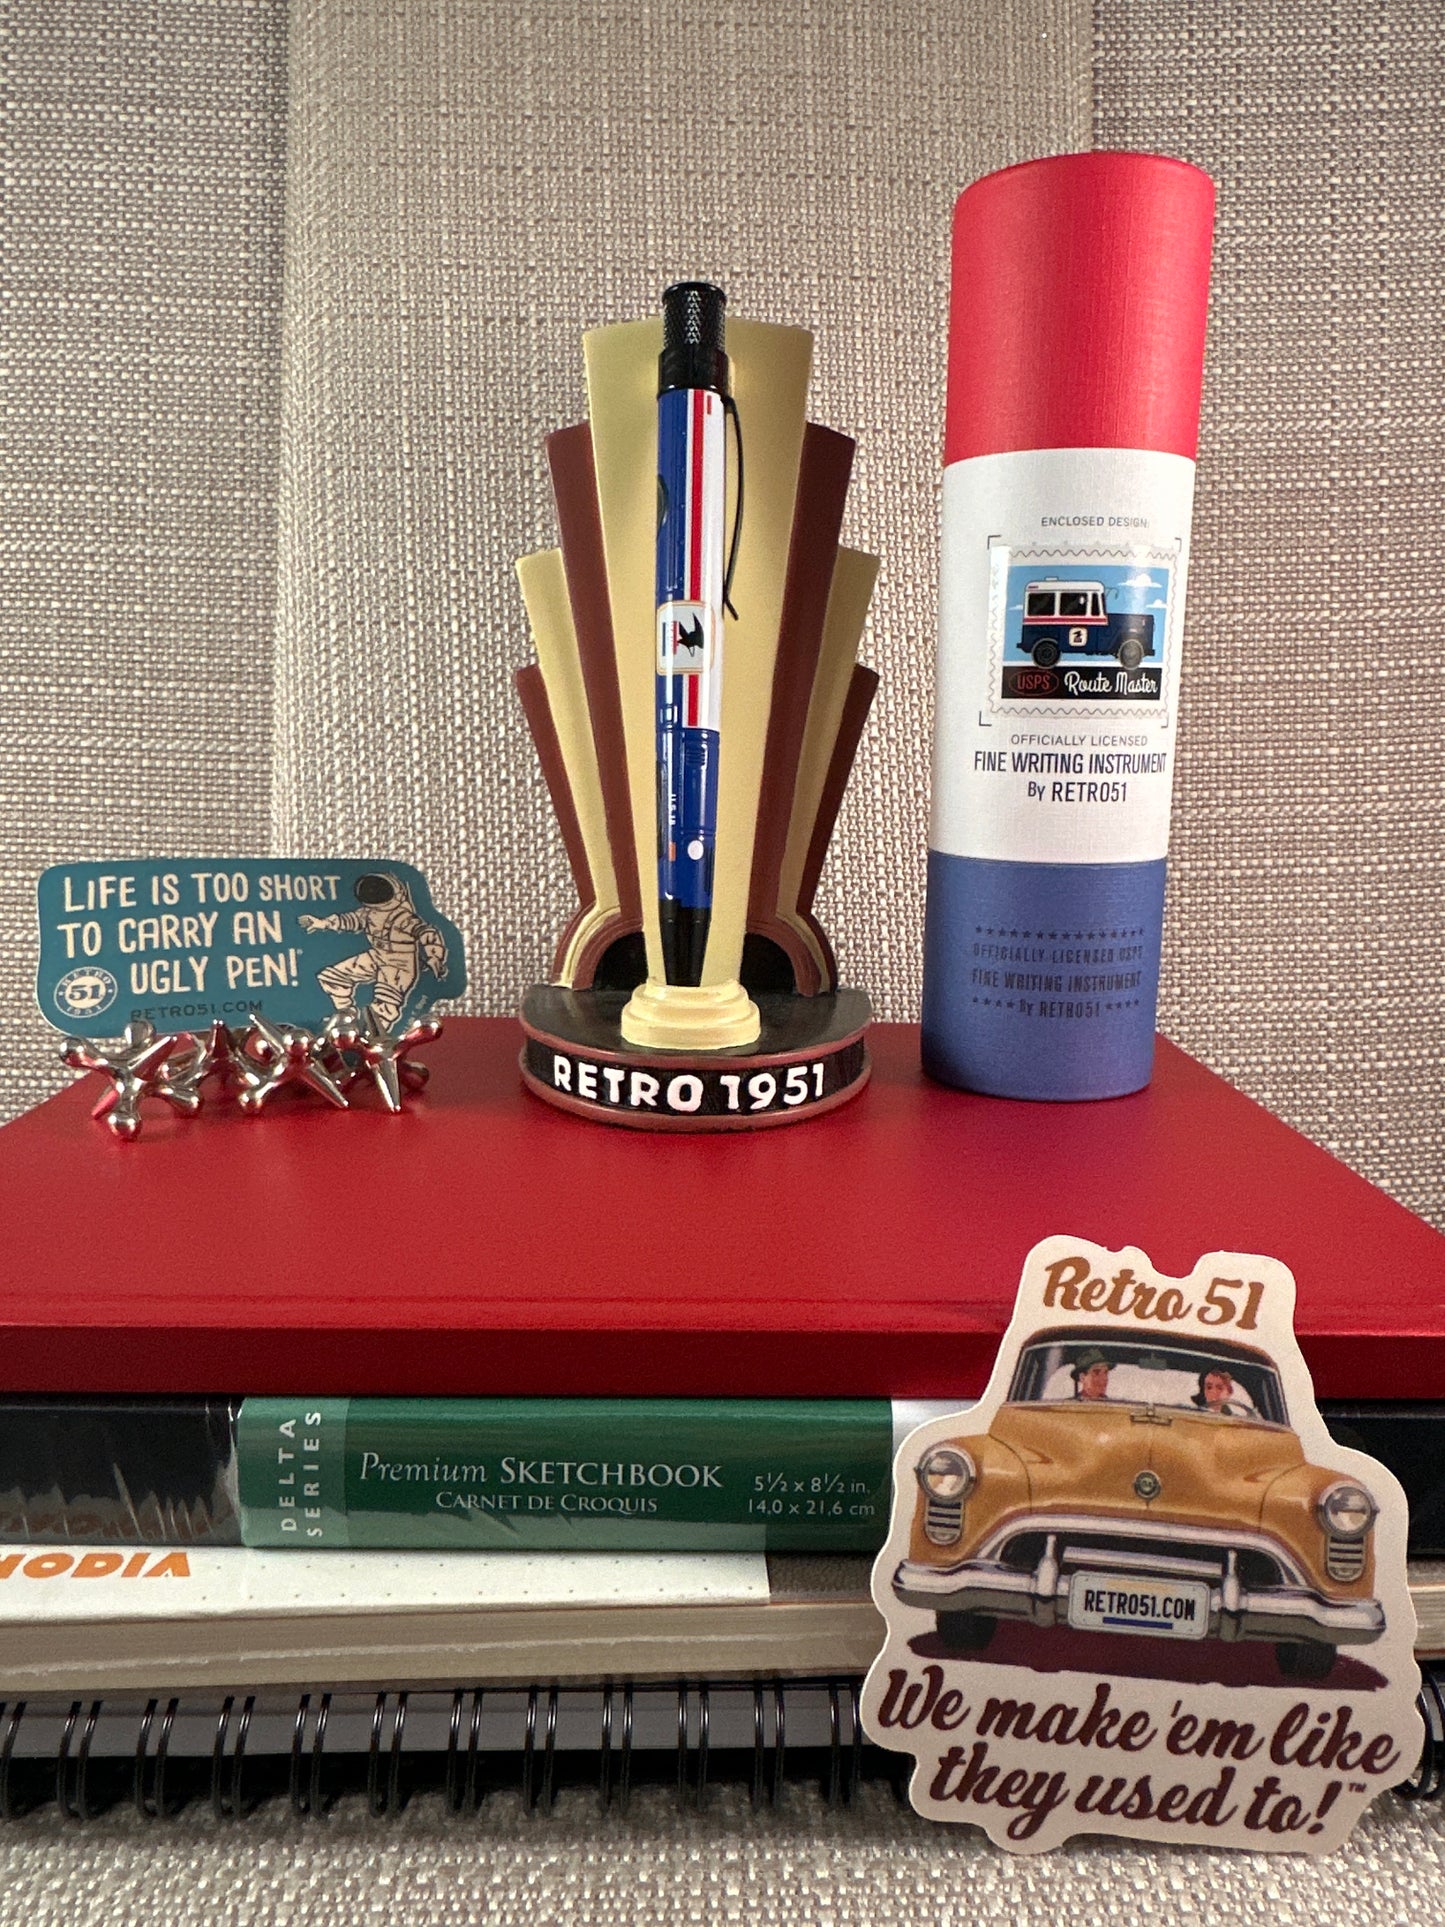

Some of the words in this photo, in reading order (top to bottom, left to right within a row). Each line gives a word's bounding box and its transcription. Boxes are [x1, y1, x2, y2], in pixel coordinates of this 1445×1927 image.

[1040, 515, 1105, 527] ENCLOSED
[1108, 516, 1149, 528] DESIGN
[1016, 673, 1050, 690] USPS
[1063, 670, 1113, 696] Route
[1113, 669, 1159, 694] Master
[1010, 734, 1086, 747] OFFICIALLY
[1091, 735, 1148, 747] LICENSED
[973, 750, 1008, 773] FINE
[1010, 751, 1084, 774] WRITING
[1088, 752, 1167, 775] INSTRUMENT
[1027, 780, 1046, 801] By
[1051, 781, 1128, 803] RETRO51
[63, 875, 138, 913] LIFE
[151, 872, 180, 907] IS
[191, 871, 249, 903] TOO
[258, 874, 342, 902] SHORT
[56, 920, 102, 959] TO
[117, 910, 220, 955] CARRY
[232, 910, 284, 946] AN
[972, 942, 1045, 963] OFFICIALLY
[1051, 947, 1114, 964] LICENSED
[129, 955, 210, 996] UGLY
[971, 967, 999, 989] FINE
[1003, 971, 1063, 993] WRITING
[1067, 970, 1142, 993] INSTRUMENT
[68, 984, 101, 1001] 51
[130, 999, 263, 1021] RETRO51.COM
[1038, 1000, 1101, 1019] RETRO51
[553, 1055, 704, 1113] RETRO
[719, 1062, 825, 1111] 1951
[1042, 1255, 1194, 1322] Retro
[1196, 1277, 1266, 1331] 51
[278, 1418, 297, 1533] DELTA
[303, 1411, 322, 1538] SERIES
[360, 1451, 488, 1484] Premium
[499, 1456, 726, 1489] SKETCHBOOK
[794, 1480, 805, 1493] x
[435, 1490, 522, 1511] CARNET
[527, 1494, 557, 1512] DE
[560, 1493, 658, 1516] CROQUIS
[788, 1502, 801, 1515] x
[848, 1504, 876, 1516] cm
[1083, 1588, 1196, 1622] RETRO51.COM
[876, 1664, 971, 1731] We
[975, 1682, 1159, 1752] make
[1165, 1698, 1265, 1762] 'em
[1268, 1701, 1402, 1776] like
[928, 1741, 1070, 1841] they
[1073, 1765, 1240, 1828] used
